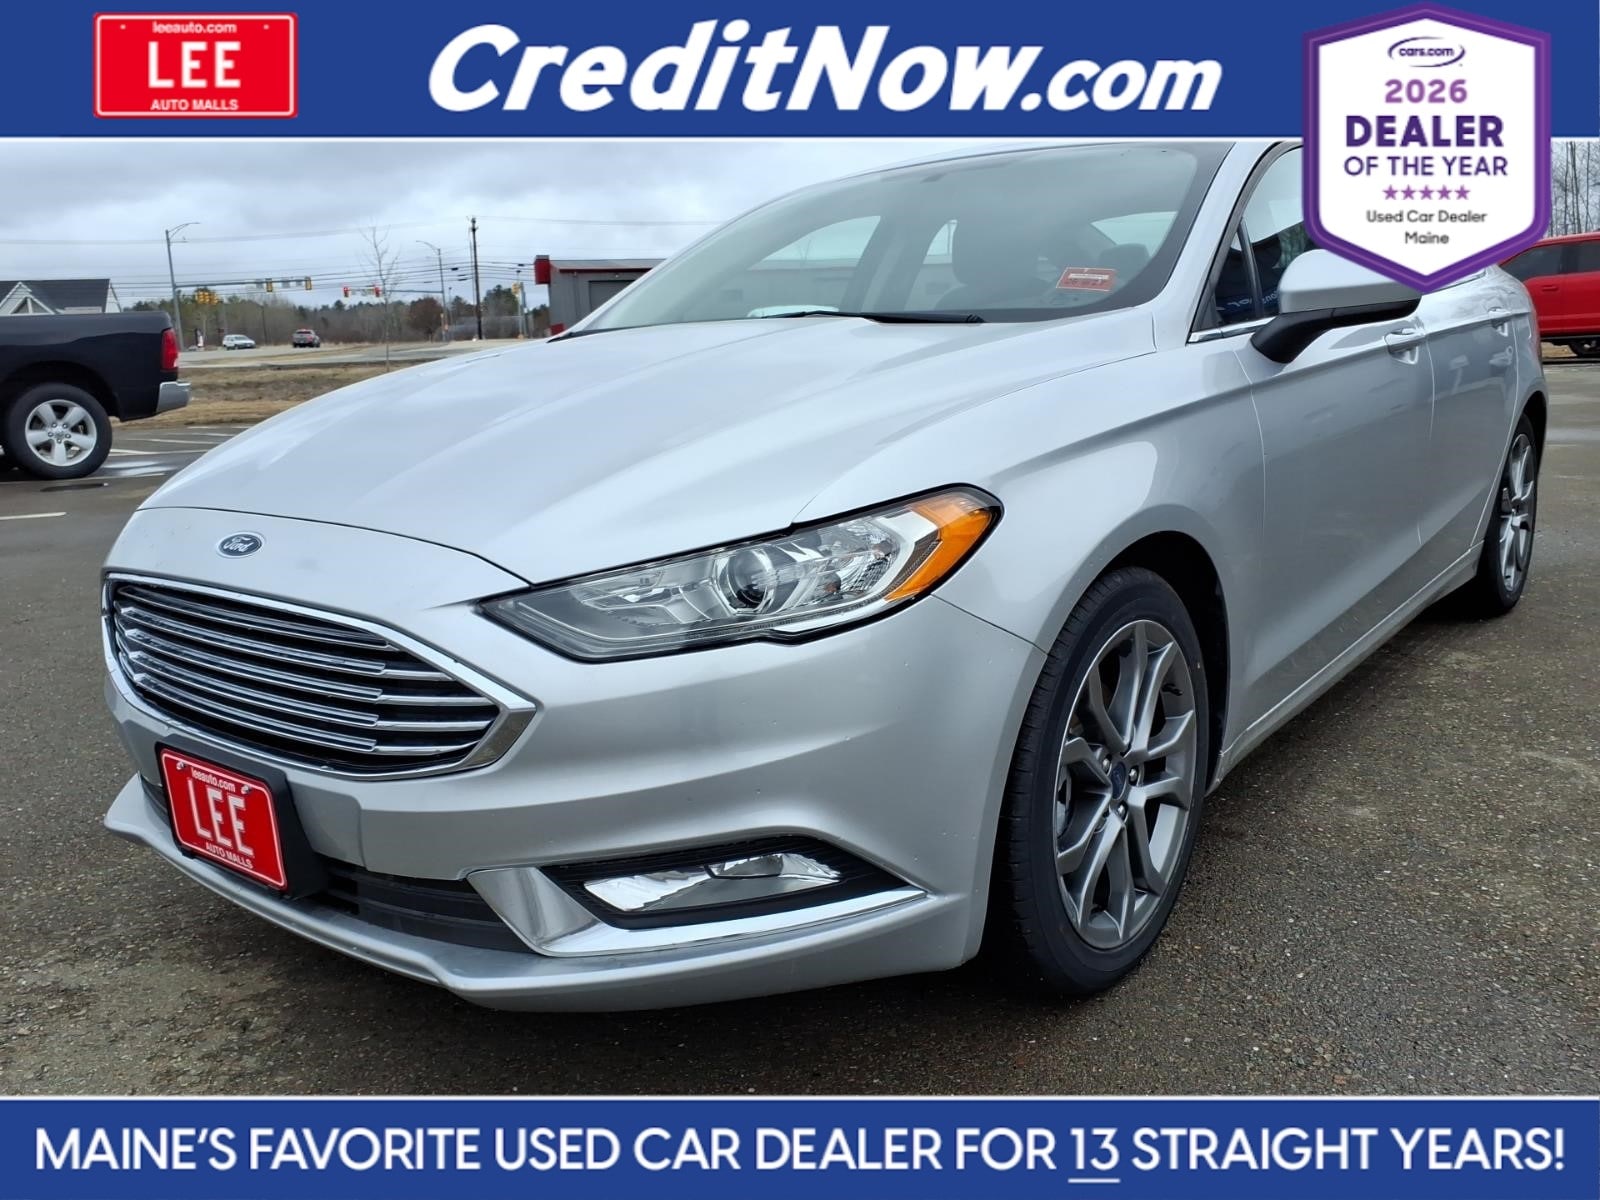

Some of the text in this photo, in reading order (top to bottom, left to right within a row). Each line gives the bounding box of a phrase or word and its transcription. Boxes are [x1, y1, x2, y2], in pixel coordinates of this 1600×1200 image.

[223, 536, 254, 552] Ford
[191, 767, 236, 792] leeauto.com
[187, 778, 254, 857] LEE
[205, 842, 253, 869] AUTO MALLS
